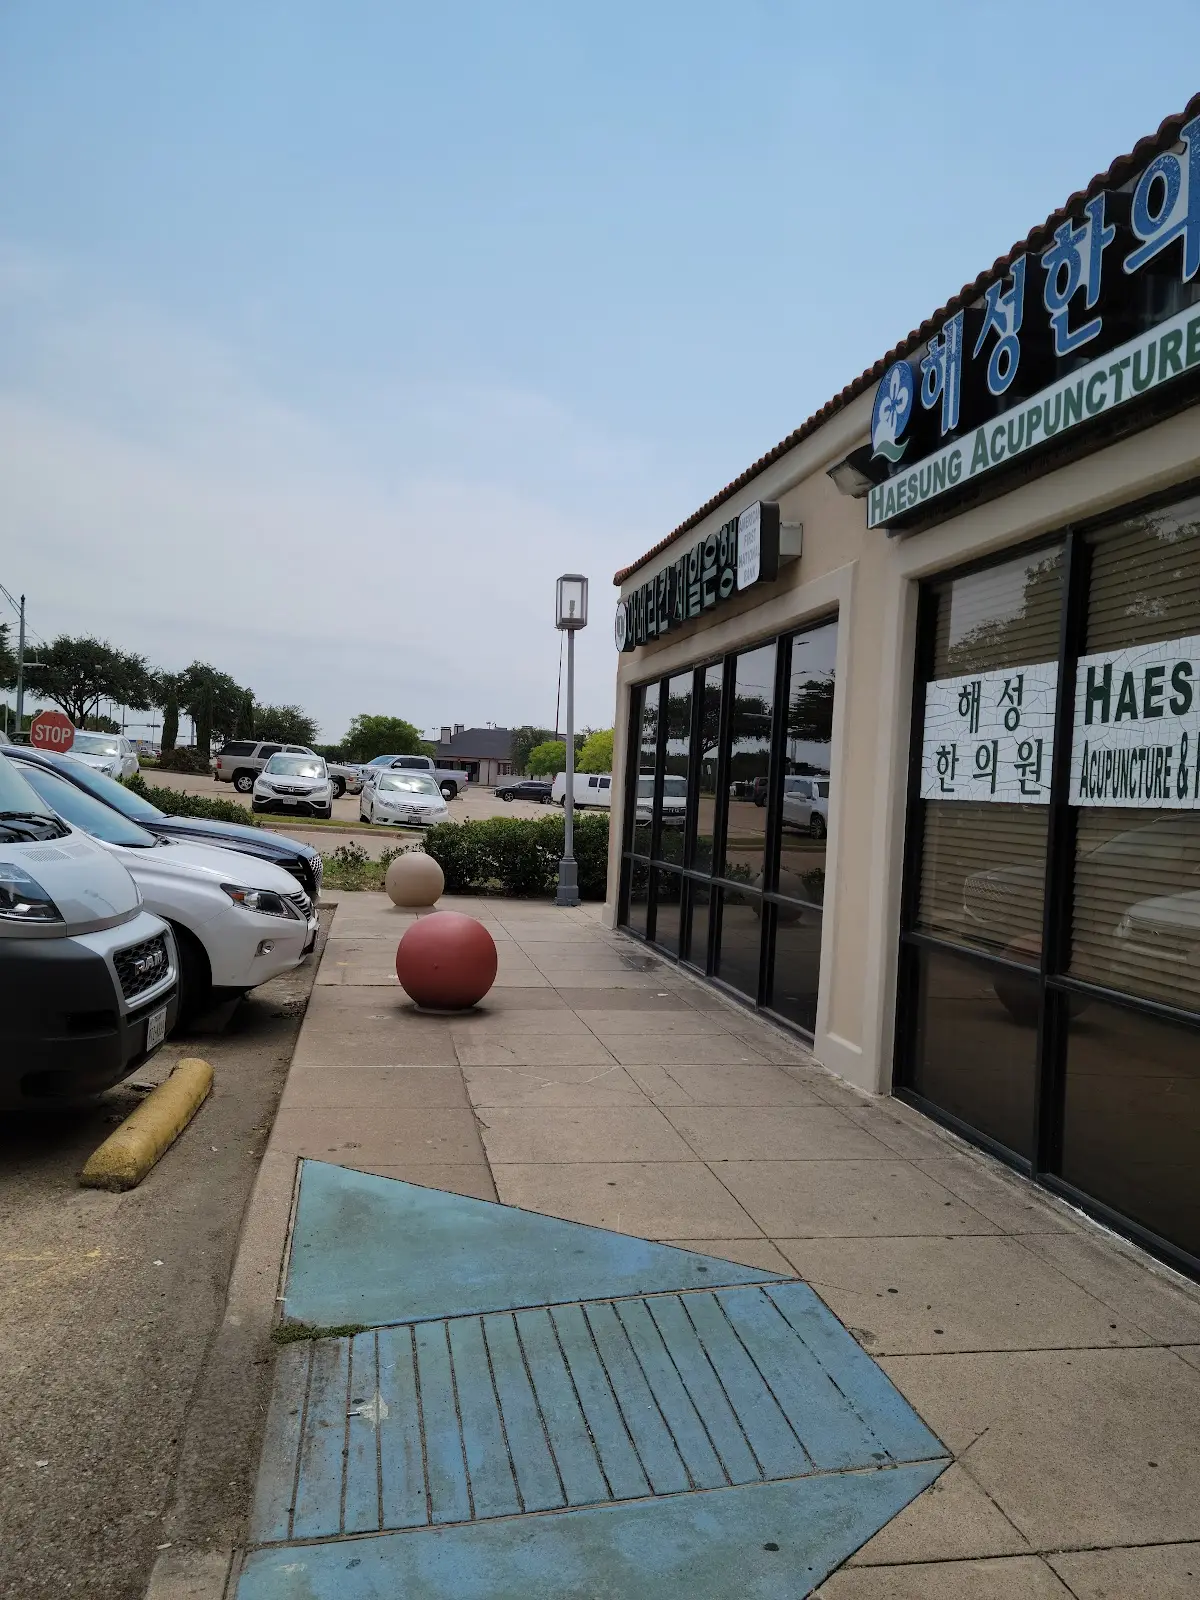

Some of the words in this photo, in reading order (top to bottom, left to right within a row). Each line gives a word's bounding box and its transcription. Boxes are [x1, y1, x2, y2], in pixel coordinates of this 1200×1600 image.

[870, 451, 962, 526] HAESUNG
[744, 527, 757, 547] FIRST
[673, 517, 737, 620] 제일은행
[744, 564, 757, 583] BANK
[35, 724, 71, 744] STOP
[1079, 740, 1173, 799] ACUPUNCTURE
[1177, 732, 1189, 799] &
